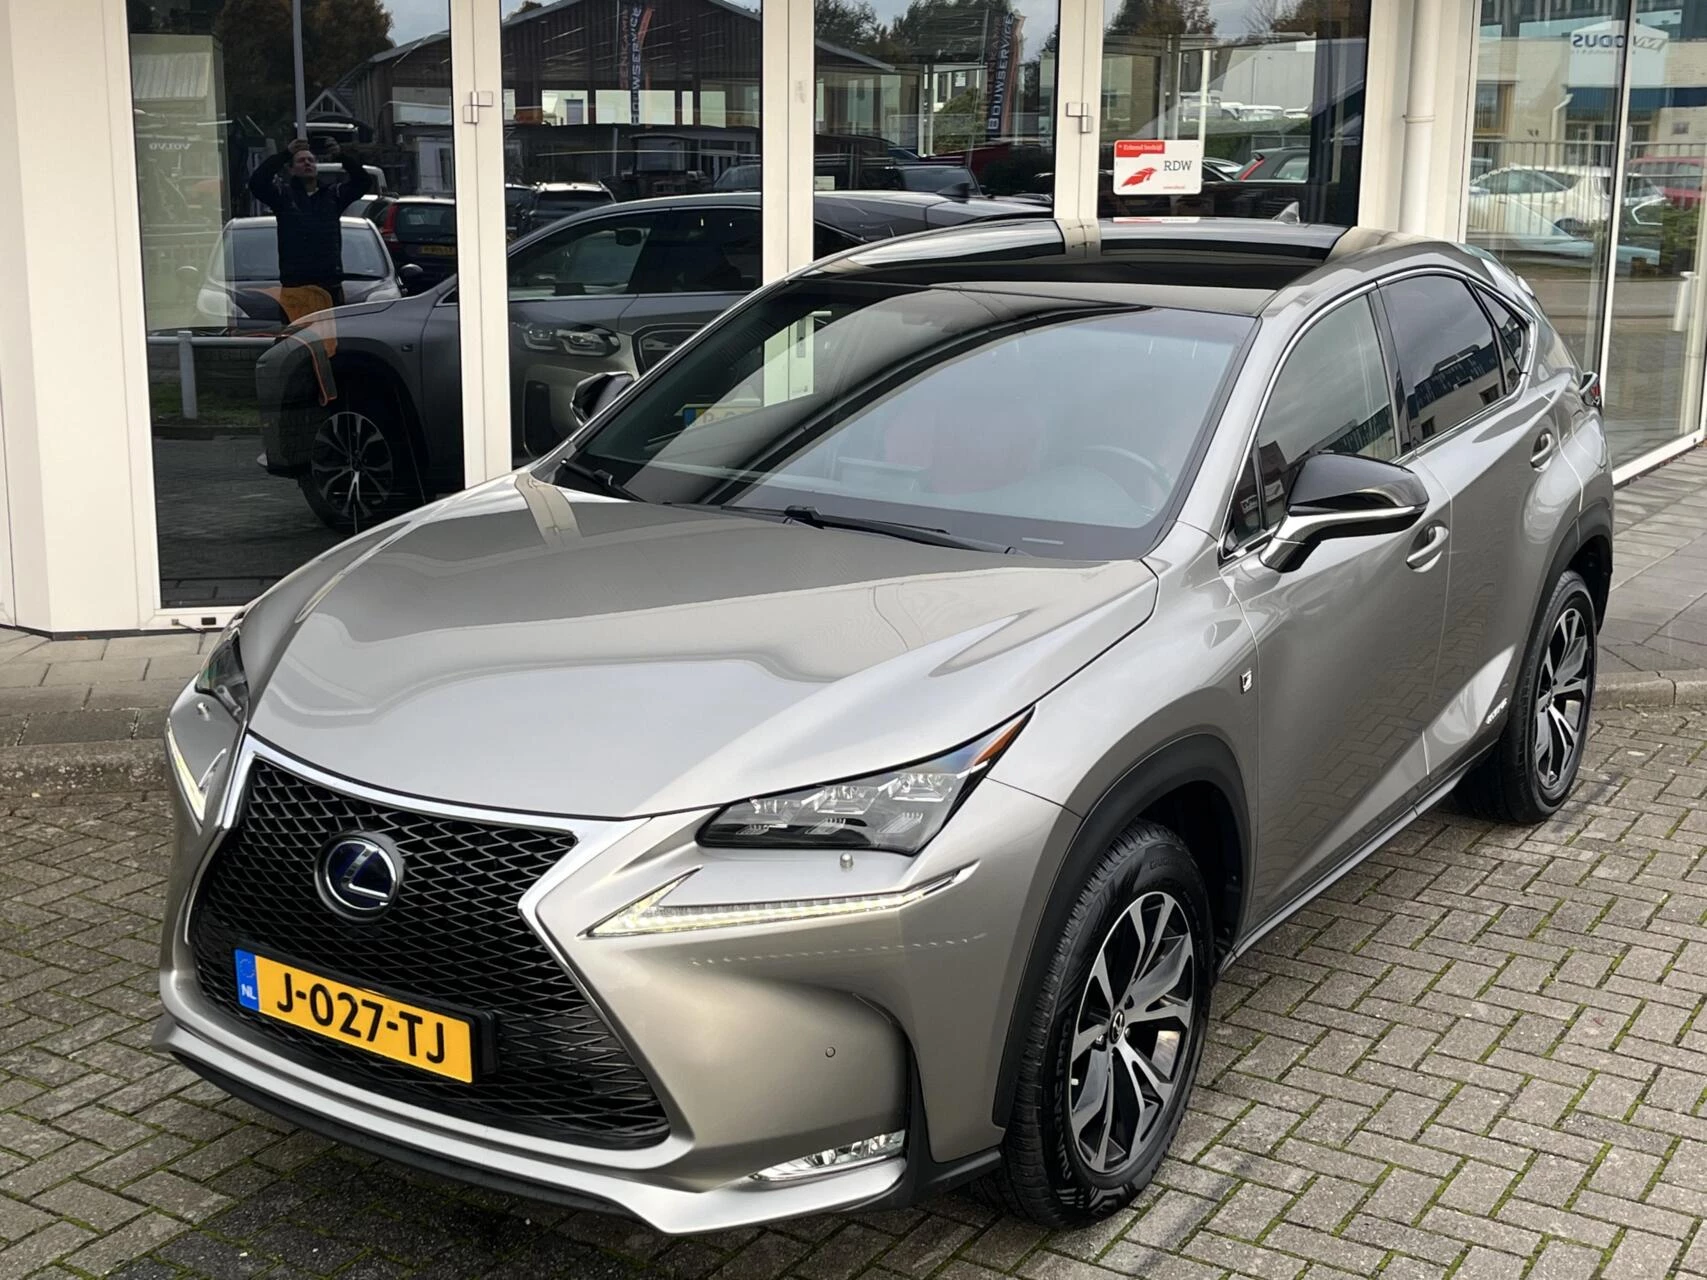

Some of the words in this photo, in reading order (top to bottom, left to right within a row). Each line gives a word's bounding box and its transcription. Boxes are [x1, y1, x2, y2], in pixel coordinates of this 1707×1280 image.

[1163, 160, 1193, 172] RDW
[241, 983, 257, 1001] NL
[276, 972, 446, 1065] J-027-TJ
